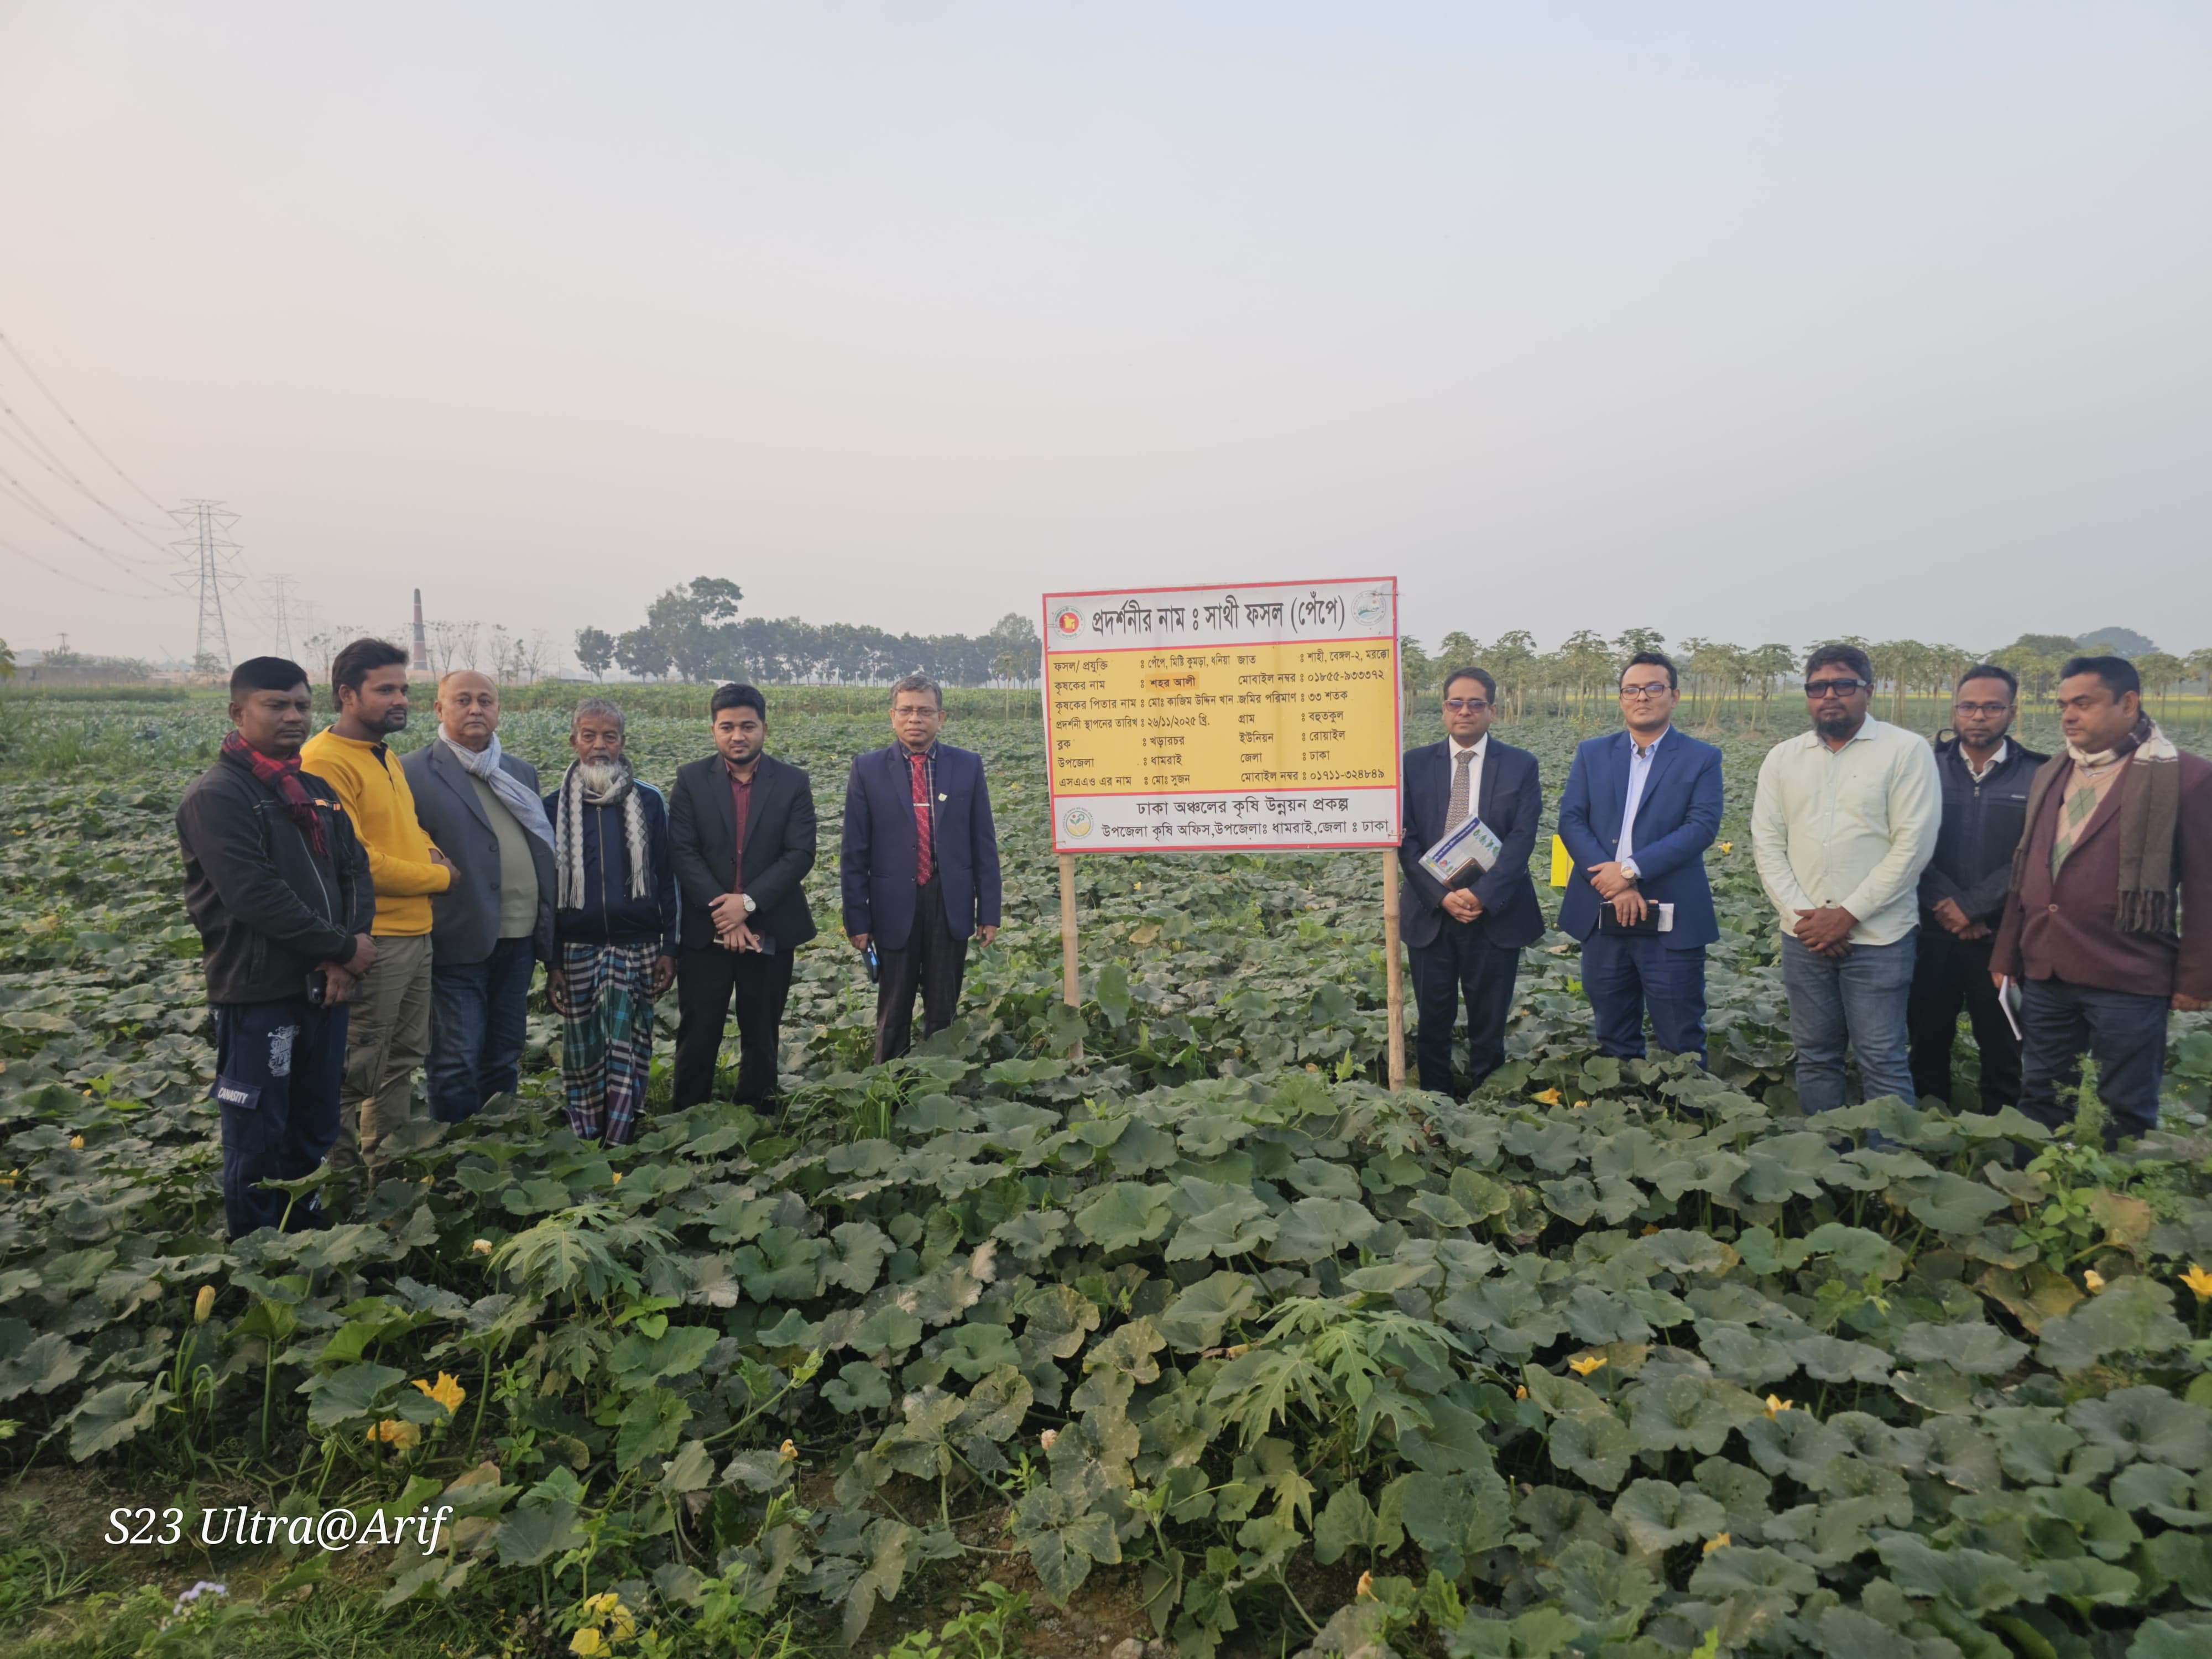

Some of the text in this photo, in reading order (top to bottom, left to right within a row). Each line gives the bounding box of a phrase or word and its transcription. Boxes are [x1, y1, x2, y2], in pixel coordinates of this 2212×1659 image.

[1092, 599, 1152, 637] প্রদর্শনীর
[1157, 604, 1185, 633] নাম
[1203, 594, 1239, 630] সাথী
[1244, 603, 1284, 628] ফসল
[1291, 591, 1344, 633] (পেঁপে)
[1053, 660, 1079, 673] ফসল/
[1083, 658, 1108, 673] প্রযুক্তি
[1148, 655, 1167, 670] পেঁপে,
[1170, 655, 1184, 668] মিষ্টি
[1211, 653, 1230, 666] ধনিয়া
[1237, 655, 1256, 665] জাত
[1307, 648, 1327, 664] শাহী,
[1054, 681, 1086, 695] কৃষকের
[1089, 681, 1105, 690] নাম
[1150, 679, 1170, 689] শহর
[1173, 675, 1196, 687] আলী
[1239, 671, 1274, 685] মোবাইল
[1277, 674, 1296, 682] নম্বর
[1307, 670, 1385, 682] ০১৮৫৫-৯৩৩৩৭২
[1055, 701, 1086, 714] কৃষকের
[1090, 697, 1117, 709] পিতার
[1120, 698, 1136, 709] নাম
[1167, 693, 1192, 707] কাজিম
[1194, 693, 1215, 705] উদ্দিন
[1219, 695, 1233, 705] খান
[1238, 692, 1261, 705] জমির
[1265, 691, 1296, 703] পরিমাণ
[1308, 693, 1322, 701] ৩৩
[1324, 691, 1348, 701] শতক
[1056, 717, 1081, 730] প্রদর্শনী
[1084, 719, 1112, 731] স্থাপনের
[1115, 716, 1138, 728] তারিখ
[1147, 716, 1196, 728] ২৬/১১/২০২৫
[1238, 714, 1255, 724] গ্রাম
[1056, 740, 1071, 750] ব্লক
[1150, 736, 1185, 748] খড়ারচর
[1239, 731, 1274, 744] ইউনিয়ন
[1310, 728, 1345, 742] রোয়াইল
[1057, 757, 1094, 768] উপজেলা
[1151, 753, 1183, 766] ধামরাই
[1240, 753, 1262, 763] জেলা
[1310, 750, 1330, 761] ঢাকা
[1059, 778, 1095, 787] এসএএও
[1099, 777, 1112, 786] এর
[1115, 776, 1131, 786] নাম
[1171, 775, 1190, 786] সুজন
[1241, 769, 1277, 782] মোবাইল
[1280, 771, 1298, 780] নম্বর
[1310, 769, 1384, 780] ০১৭১১-৩২৪৮৪৯
[1136, 795, 1349, 818] ঢাকা অঞ্চলের কৃষি উন্নয়ন প্রকল্প
[1102, 823, 1147, 838] উপজেলা
[1152, 822, 1172, 842] কৃষি
[1361, 820, 1389, 833] ঢাকা
